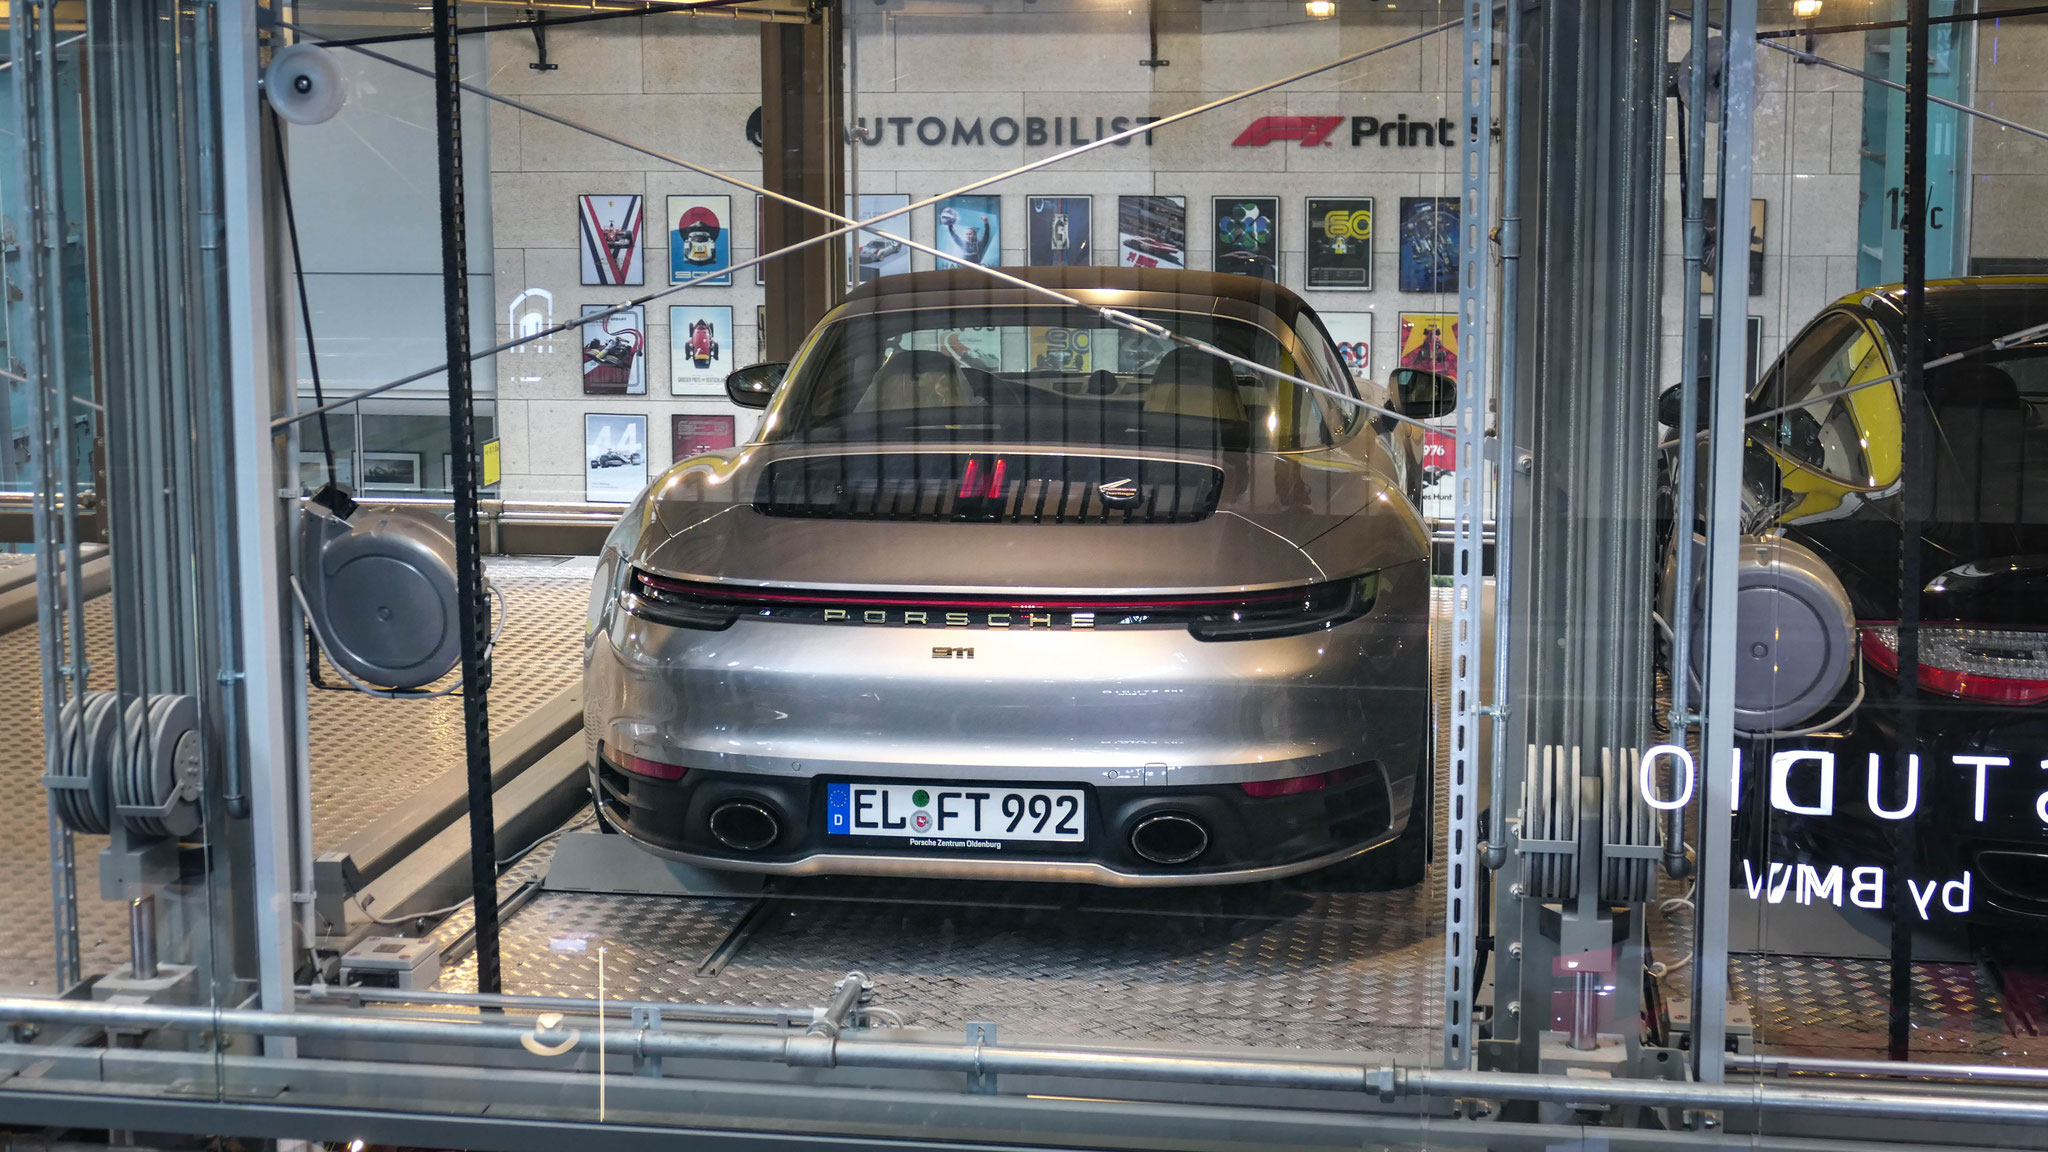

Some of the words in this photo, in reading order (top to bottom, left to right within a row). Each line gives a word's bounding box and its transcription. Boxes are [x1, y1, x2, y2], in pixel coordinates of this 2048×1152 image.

[1352, 114, 1455, 147] Print
[589, 423, 642, 454] 44
[824, 609, 1095, 628] PORSCHE
[932, 647, 974, 659] 911
[834, 815, 843, 826] D
[854, 789, 907, 829] EL
[937, 792, 990, 832] FT
[1001, 793, 1079, 835] 992
[910, 838, 936, 847] Porsche
[937, 839, 966, 848] Zentrum
[966, 840, 1001, 849] Oldenburg
